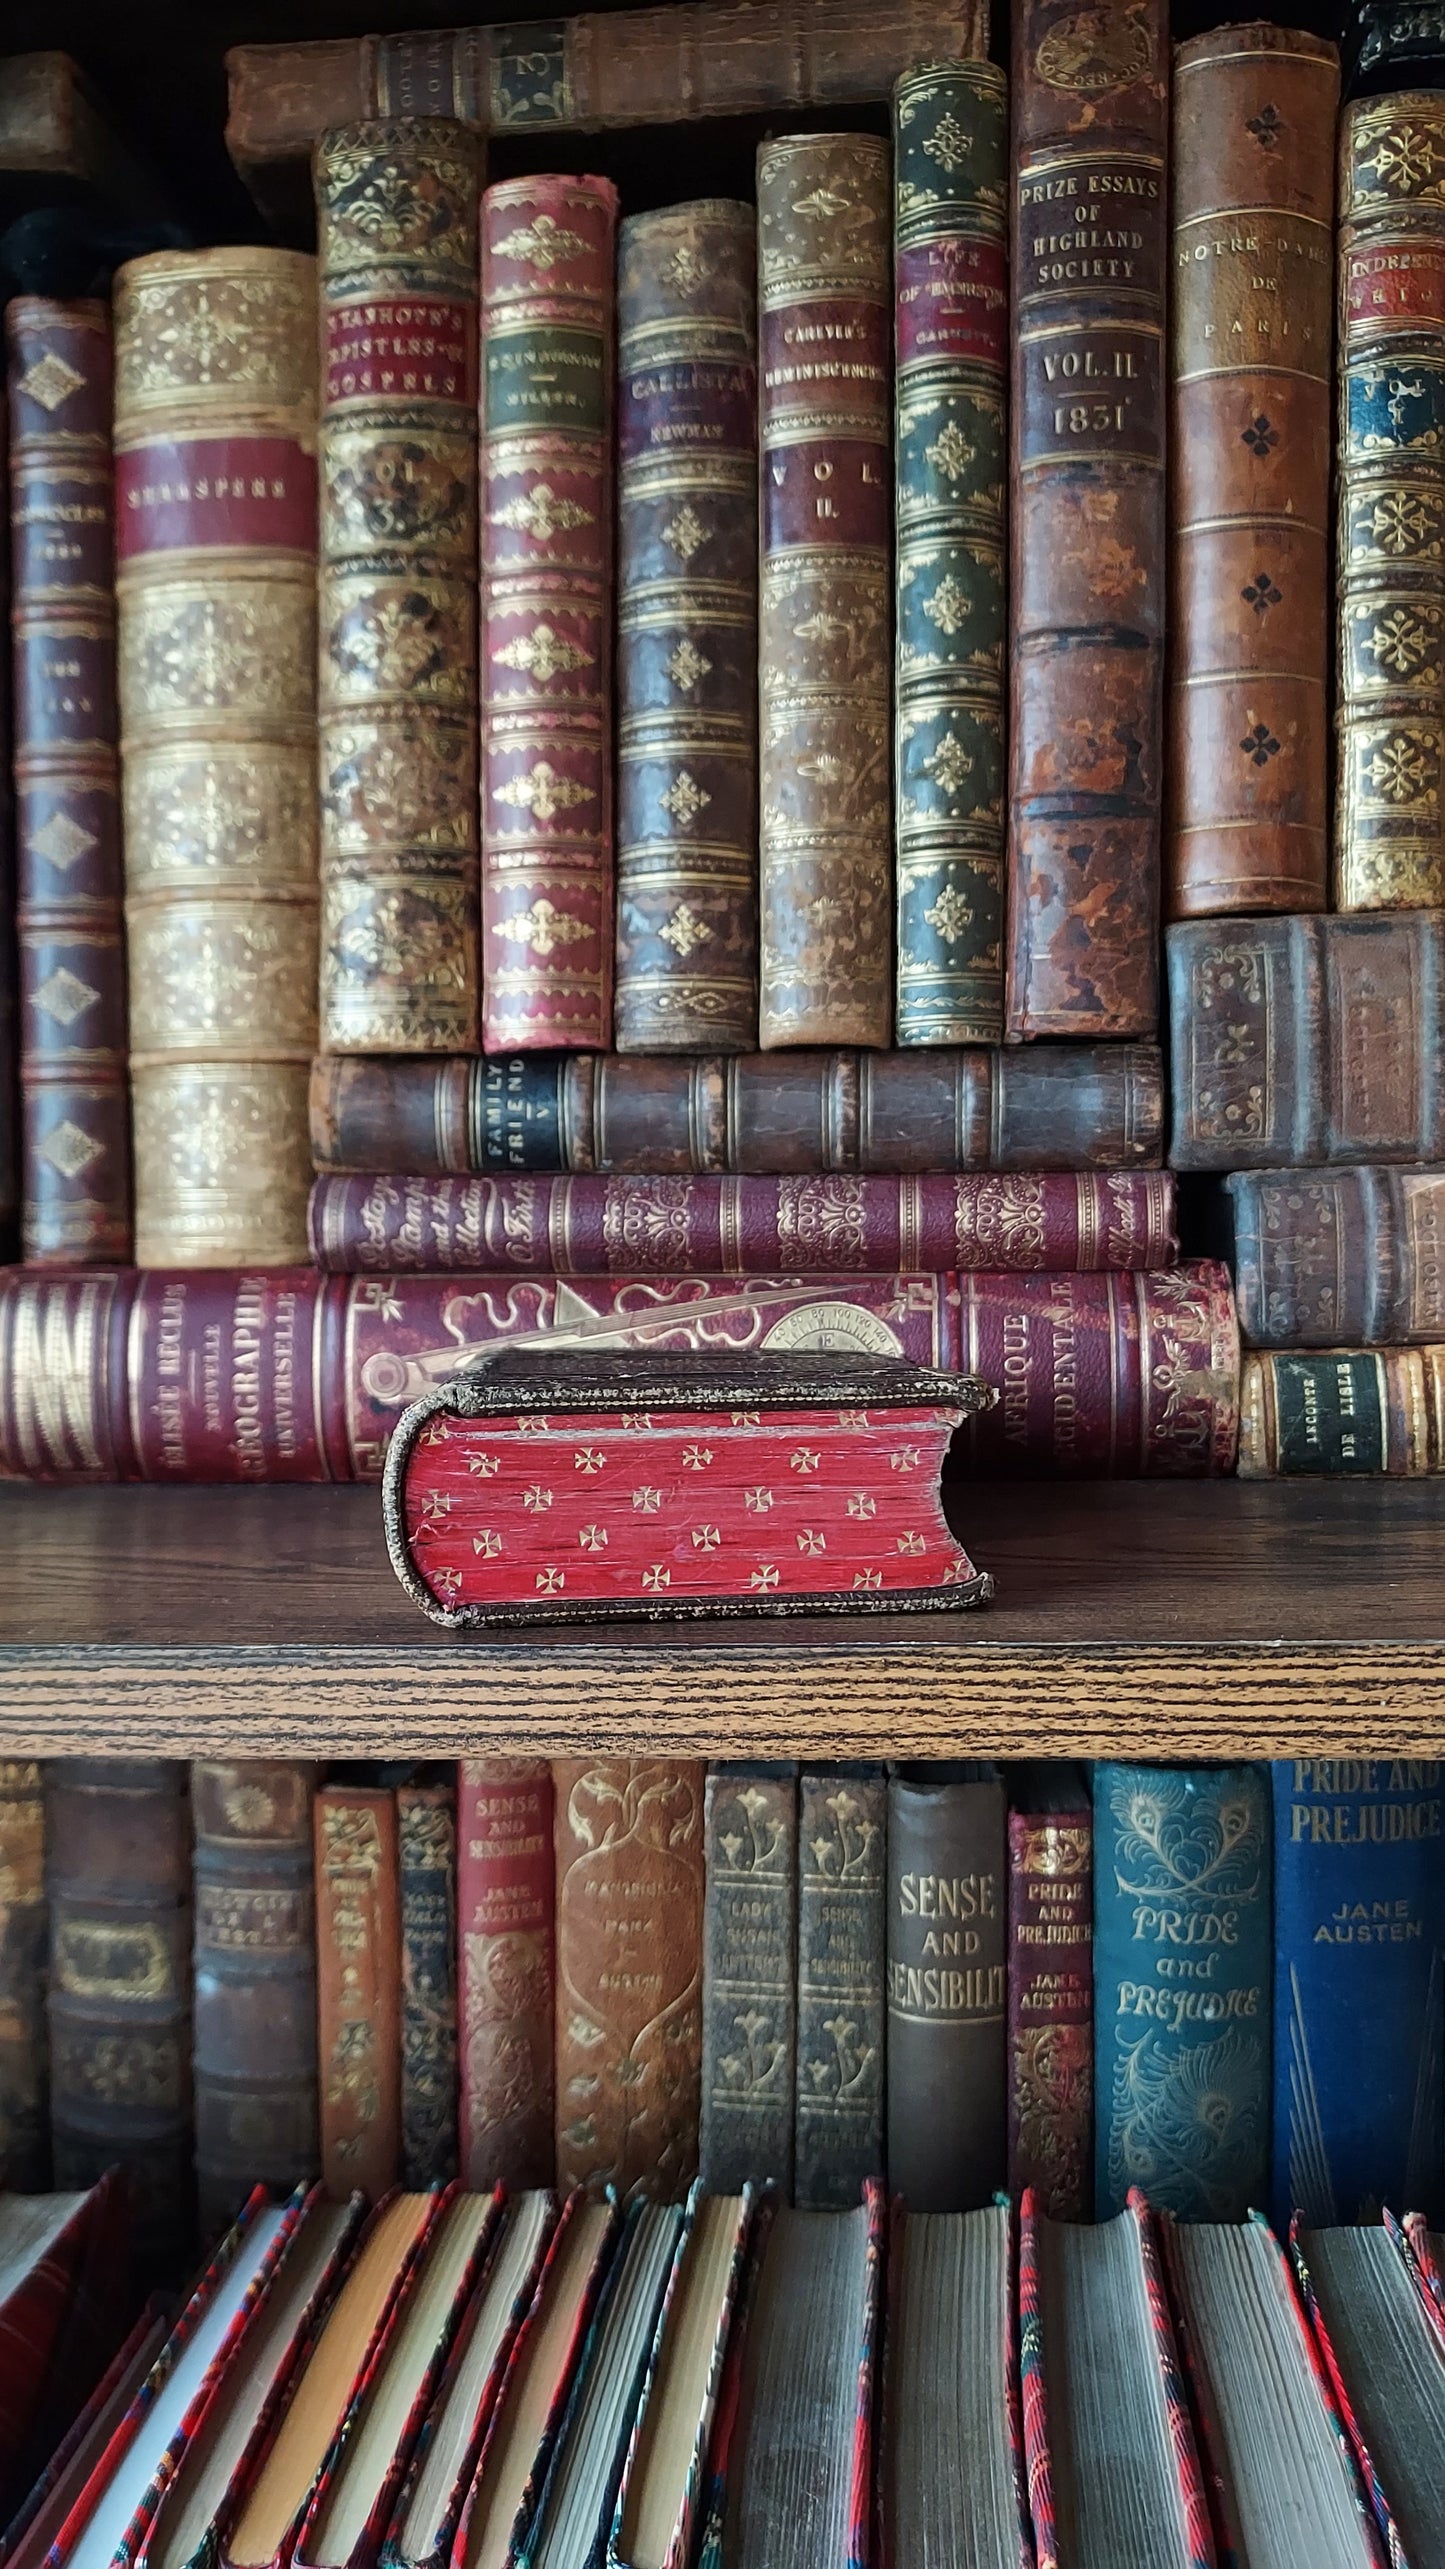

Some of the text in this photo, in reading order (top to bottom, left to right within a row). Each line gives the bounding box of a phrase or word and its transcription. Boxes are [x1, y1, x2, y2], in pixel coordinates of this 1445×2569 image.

[1020, 176, 1158, 206] PRIZE ESSAYS
[1075, 205, 1100, 222] OF
[1033, 230, 1143, 256] HIGHLAND
[1038, 259, 1136, 283] SOCIETY
[1252, 276, 1277, 291] DE
[1205, 320, 1311, 340] PARIS
[1044, 352, 1108, 381] VOL.
[632, 372, 747, 399] CALLISTA
[486, 1064, 503, 1156] FAMILY
[506, 1059, 525, 1165] FRIEND
[536, 1101, 549, 1119] V
[157, 1283, 188, 1376] RECLUS
[811, 1308, 825, 1319] 80
[833, 1308, 851, 1319] 100
[855, 1314, 871, 1328] 120
[873, 1327, 888, 1344] 140
[203, 1323, 221, 1434] NOUVELLE
[228, 1275, 268, 1477] GÉOGRAPHIE
[273, 1292, 297, 1459] UNIVERSELLE
[1003, 1314, 1032, 1446] AFRIQUE
[1303, 1378, 1318, 1444] LECONTE
[1341, 1433, 1356, 1458] DE
[1293, 1759, 1379, 1793] PRIDE
[475, 1794, 540, 1817] SENSE
[488, 1820, 526, 1837] AND
[1289, 1799, 1441, 1843] PREJUDICE
[900, 1872, 996, 1920] SENSE
[1028, 1882, 1083, 1901] PRIDE
[473, 1900, 544, 1924] AUSTEN
[1038, 1906, 1076, 1922] AND
[1332, 1901, 1410, 1920] JANE
[1017, 1925, 1092, 1944] PREJUDICE
[1132, 1905, 1240, 1946] PRIDE
[1314, 1921, 1423, 1944] AUSTEN
[922, 1930, 982, 1958] AND
[1156, 1953, 1220, 1979] and
[1031, 1973, 1080, 1989] JANE
[1020, 1990, 1092, 2010] AUSTEN
[1117, 1981, 1261, 2034] PREJUDICE
